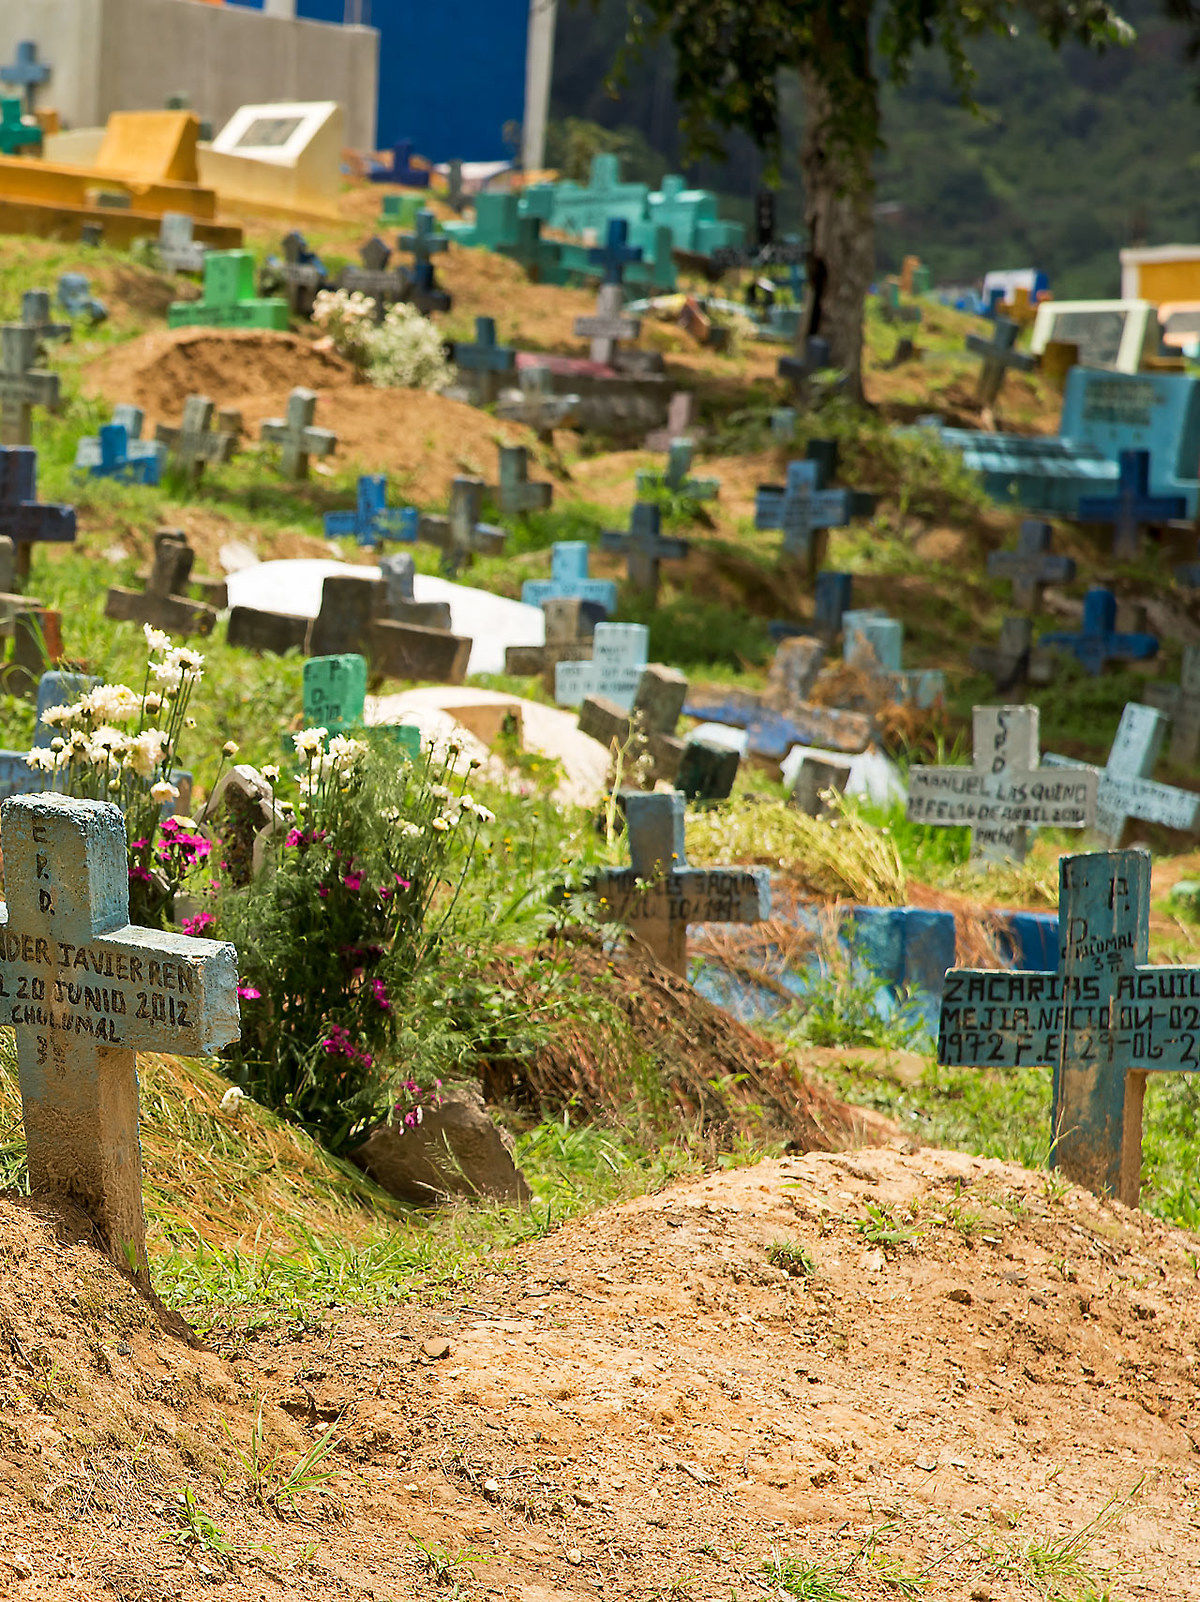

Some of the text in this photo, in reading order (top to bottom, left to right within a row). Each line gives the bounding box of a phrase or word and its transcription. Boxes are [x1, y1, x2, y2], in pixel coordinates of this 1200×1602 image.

[57, 941, 144, 983] JAVIER
[16, 976, 46, 1001] 20
[55, 979, 128, 1015] JUNIO
[135, 991, 194, 1028] 2012
[944, 975, 1100, 1002] ZACARIAS
